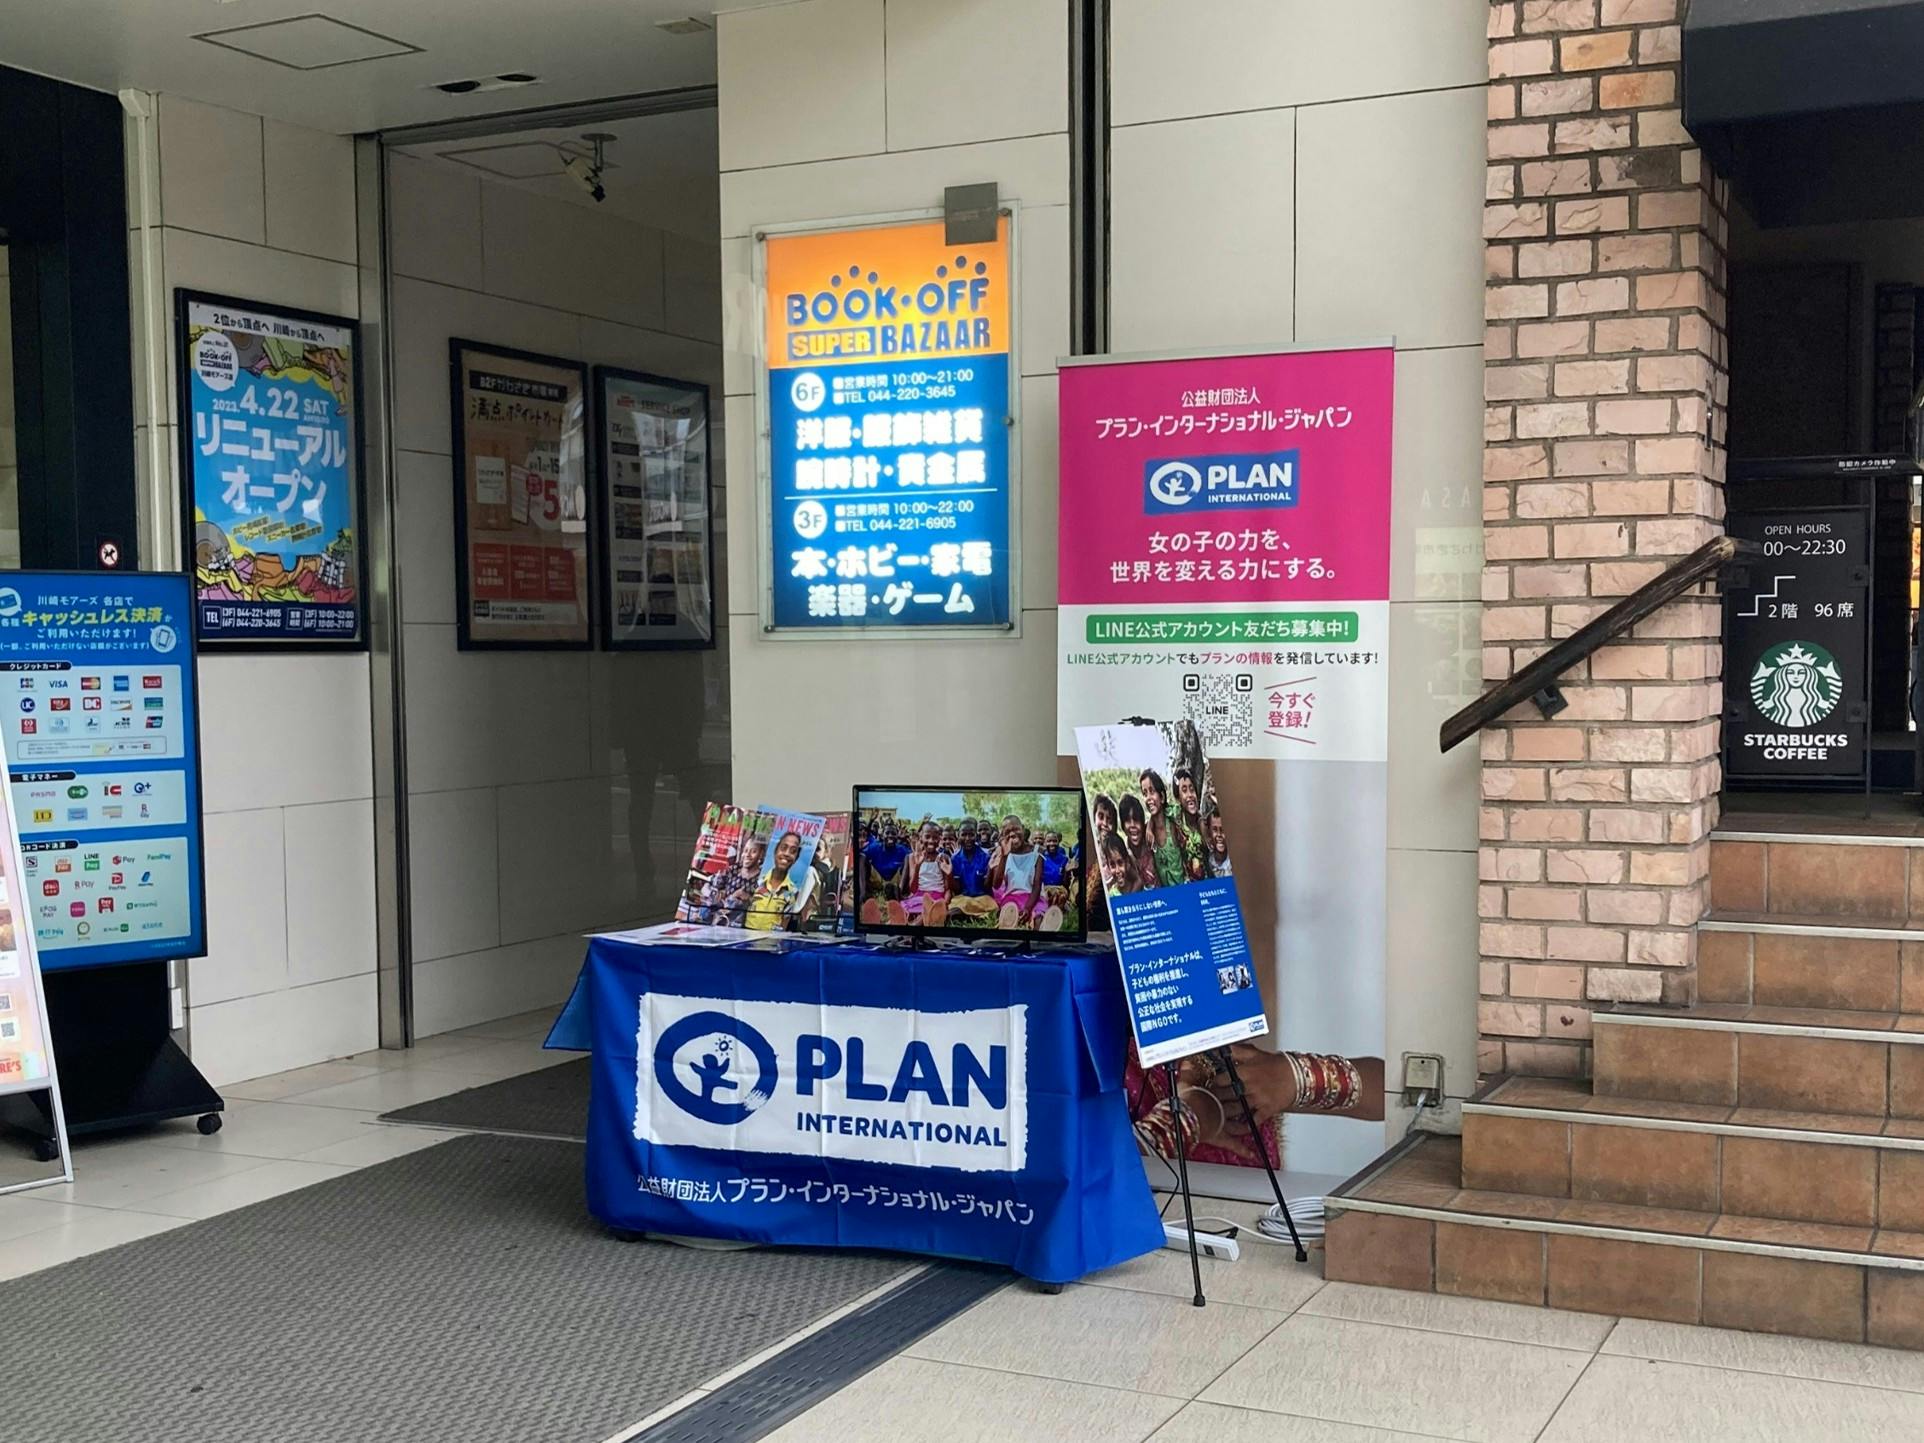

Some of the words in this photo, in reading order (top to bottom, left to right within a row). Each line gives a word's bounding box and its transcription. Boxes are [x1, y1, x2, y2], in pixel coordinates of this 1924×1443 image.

[791, 330, 872, 357] SUPER
[881, 317, 991, 354] BAZAAR
[795, 382, 820, 402] 6F
[844, 391, 866, 404] TEL
[868, 385, 956, 402] 044-220-3645
[1181, 386, 1262, 408] 公益財団法人
[303, 398, 330, 415] SAT
[1095, 407, 1353, 440] プラン・インターナショナル・ジャパン
[196, 411, 347, 468] リニューアル
[1207, 462, 1293, 490] PLAN
[221, 465, 327, 513] オープン
[1207, 491, 1292, 504] INTERNATIONAL
[797, 511, 822, 530] 3F
[845, 519, 868, 533] TEL
[869, 516, 957, 532] 044-221-6905
[1765, 525, 1792, 535] OPEN
[1796, 523, 1832, 534] HOURS
[1148, 528, 1292, 555] 女の子の力を、
[1109, 557, 1337, 583] 世界を変える力にする。
[206, 611, 220, 624] TEL
[1095, 618, 1350, 640] LINE公式アカウント友だち募集中!
[1067, 651, 1379, 666] LINE公式アカウントでもプランの情報を発信しています!
[49, 680, 68, 689] VISA
[21, 700, 35, 710] UC
[1268, 691, 1317, 710] 今すぐ
[1205, 705, 1230, 716] LINE
[1268, 710, 1313, 729] 登録!
[1744, 734, 1848, 747] STARBUCKS
[1763, 747, 1828, 760] COFFEE
[787, 818, 820, 838] NEWS
[84, 853, 100, 861] LINE
[796, 1033, 1008, 1110] PLAN
[796, 1111, 1008, 1147] INTERNATIONAL
